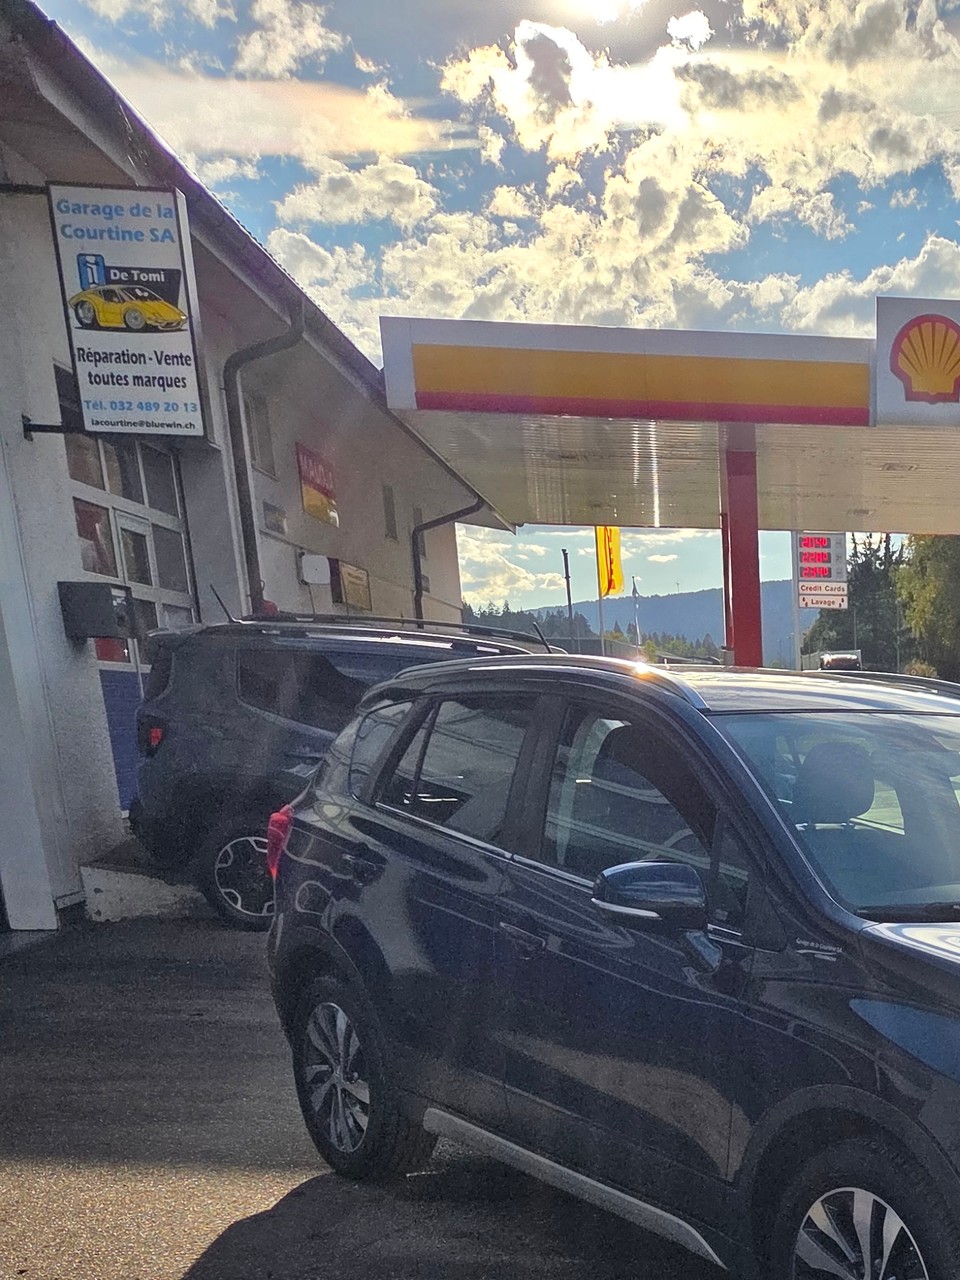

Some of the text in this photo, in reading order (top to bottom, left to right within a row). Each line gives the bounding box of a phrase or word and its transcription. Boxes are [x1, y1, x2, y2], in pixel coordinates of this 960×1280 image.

[56, 198, 174, 220] Garage de la
[60, 223, 176, 243] Courtine SA
[110, 269, 165, 282] De Tomi
[76, 347, 147, 367] Réparation
[153, 350, 192, 366] Vente
[88, 371, 187, 392] toutes marques
[110, 401, 133, 411] 032
[136, 401, 160, 412] 489
[163, 402, 179, 412] 20
[183, 402, 198, 412] 13
[91, 418, 196, 430] lacourtine@bluewin.ch
[800, 584, 822, 592] Credit
[811, 598, 836, 607] Lavage
